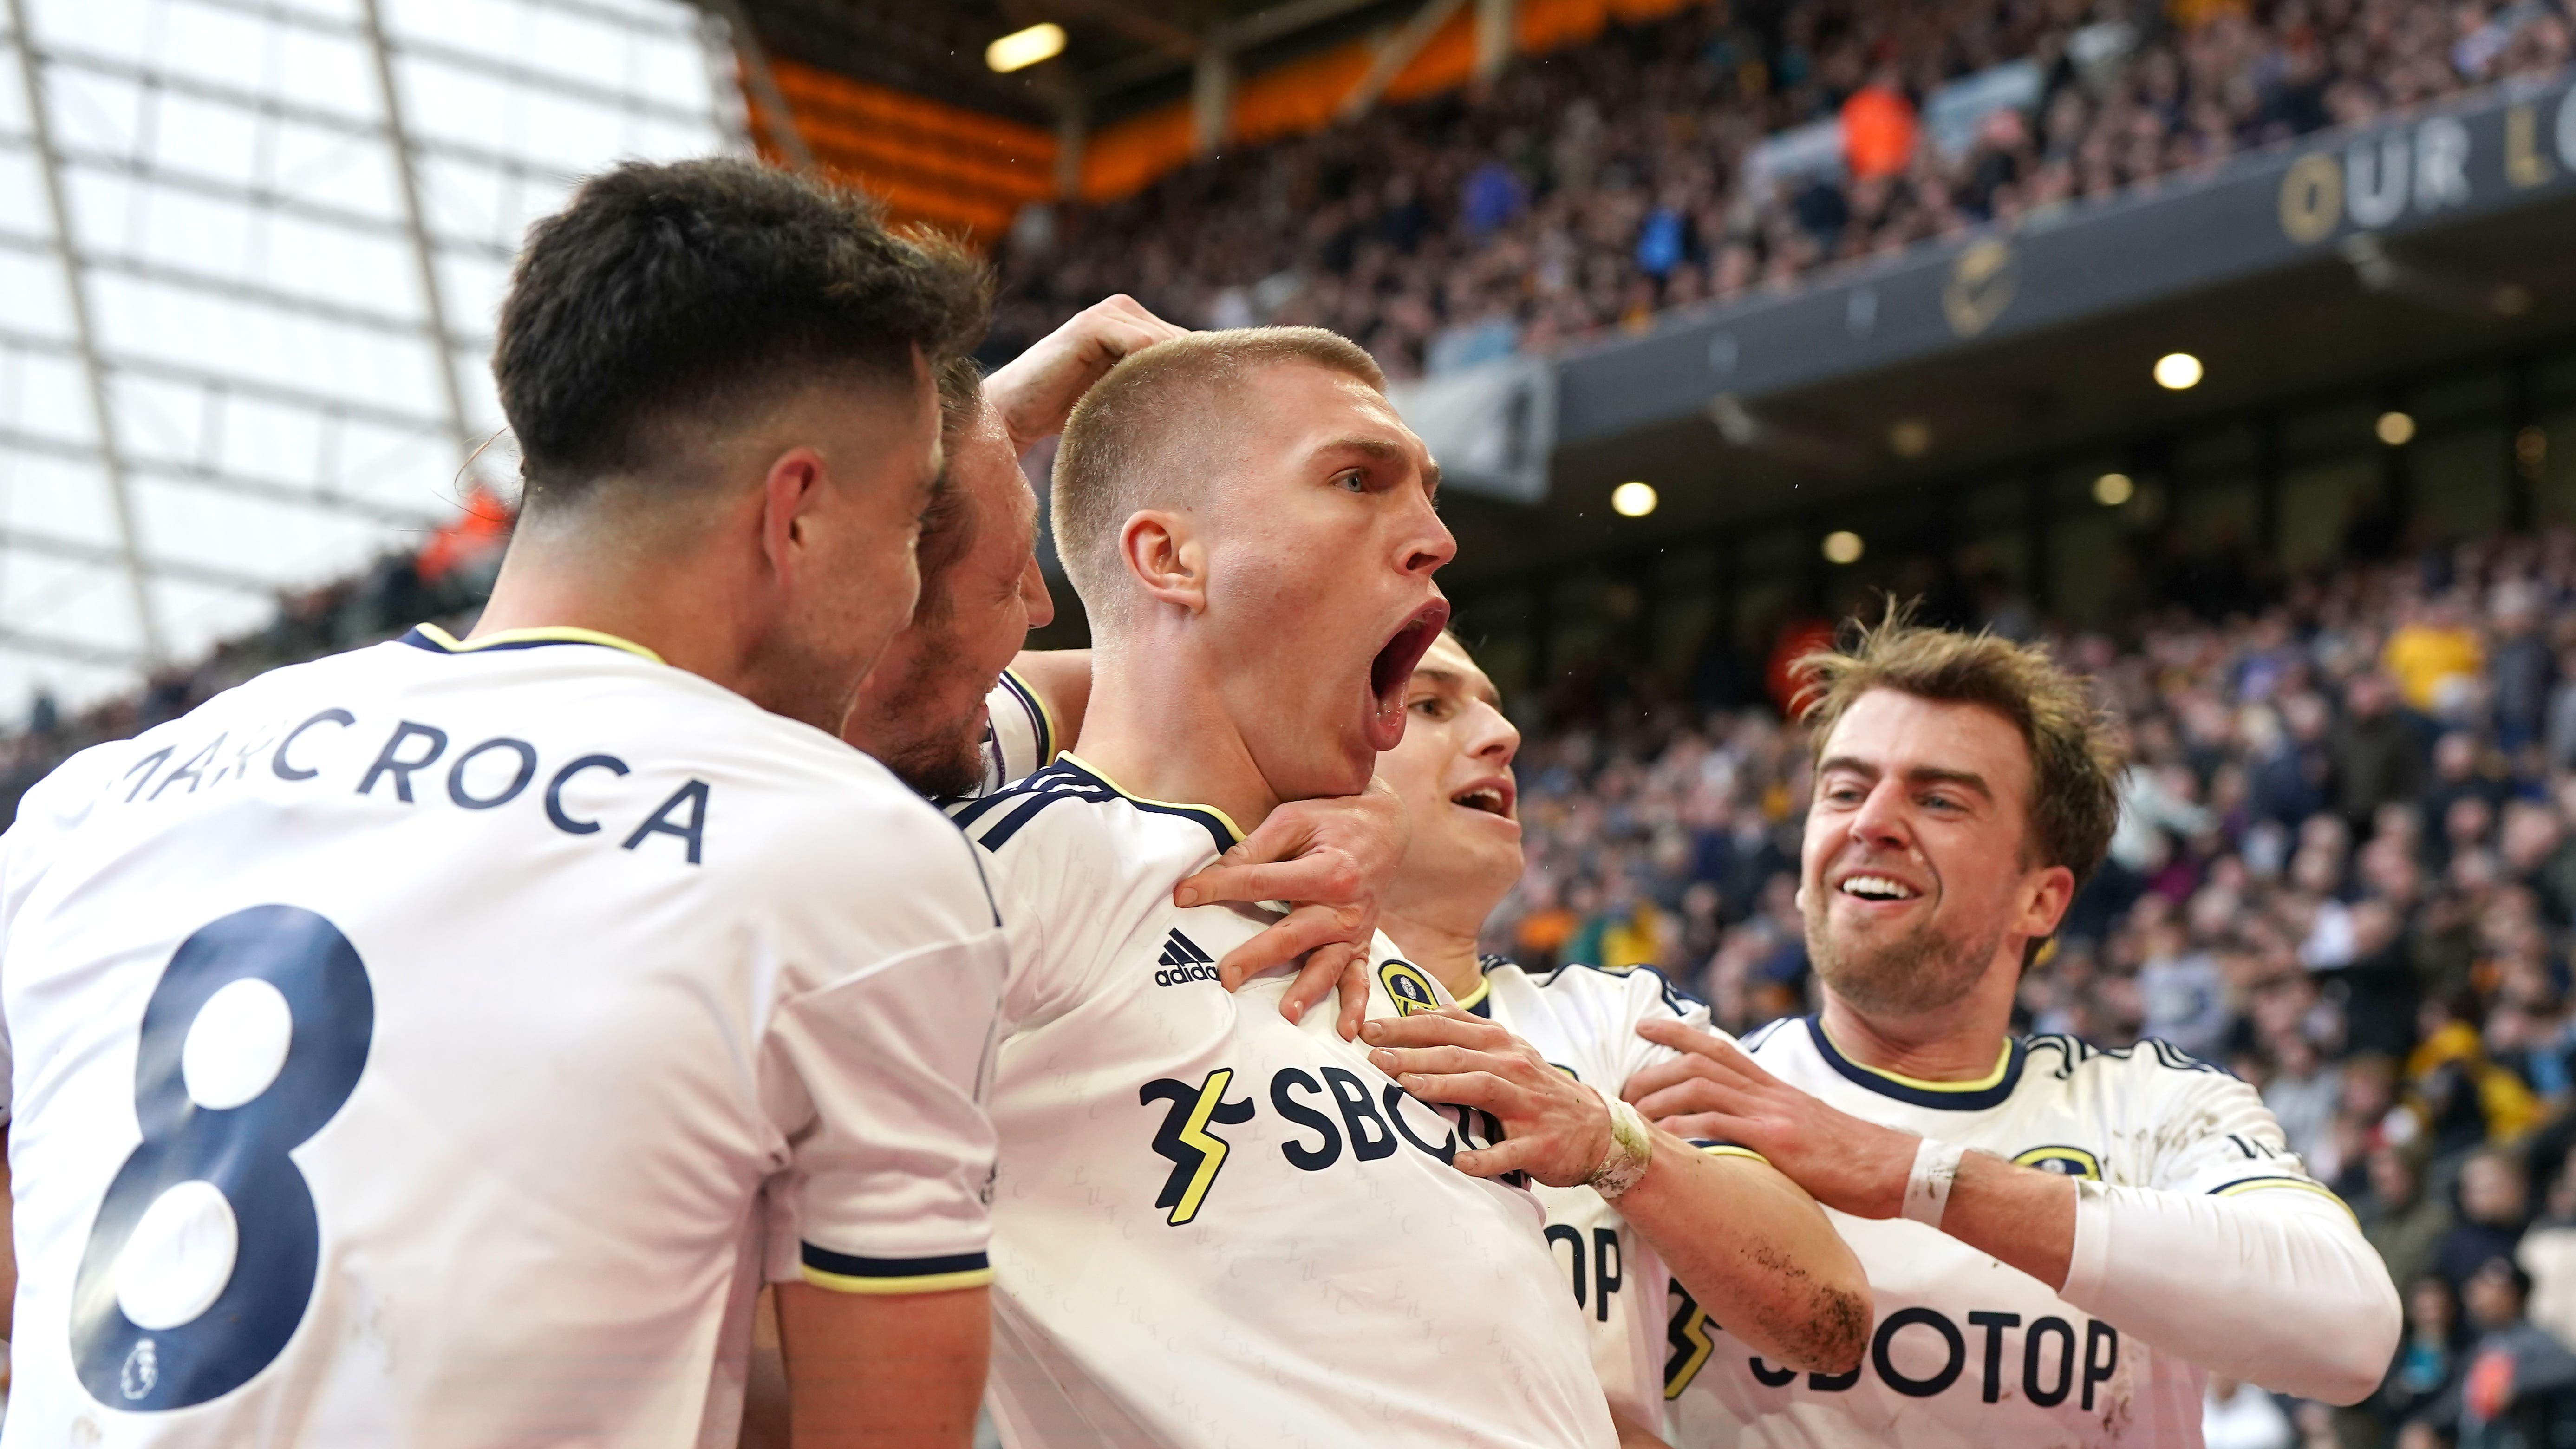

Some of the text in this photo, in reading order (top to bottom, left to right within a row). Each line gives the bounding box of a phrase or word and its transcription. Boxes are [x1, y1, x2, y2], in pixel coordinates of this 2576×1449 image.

[2280, 116, 2469, 245] OUR
[356, 720, 710, 865] ROCA
[1154, 961, 1220, 987] adida
[68, 903, 373, 1411] 8
